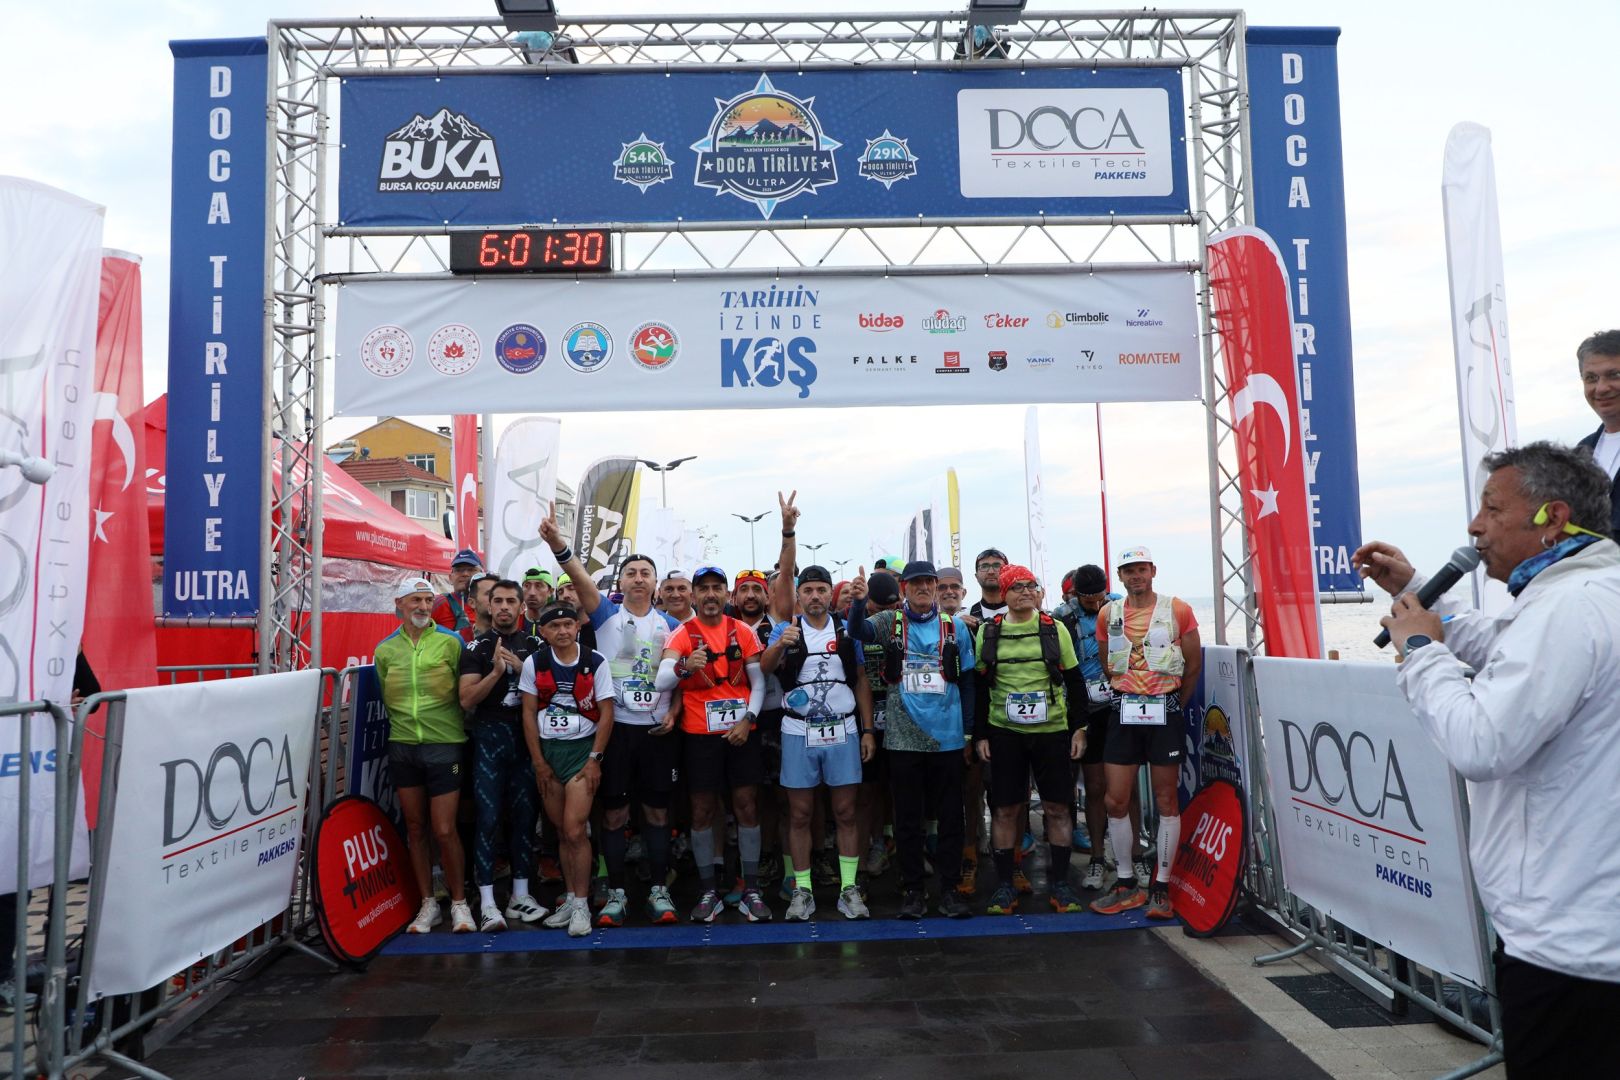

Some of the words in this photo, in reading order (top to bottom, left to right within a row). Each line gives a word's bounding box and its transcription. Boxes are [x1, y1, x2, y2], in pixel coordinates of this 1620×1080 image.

[984, 105, 1145, 151] DOCA
[1281, 53, 1311, 208] DOCA
[206, 66, 232, 225] DOCA
[873, 147, 903, 160] 29K
[381, 140, 500, 179] BUKA
[629, 151, 659, 163] 54K
[716, 157, 756, 173] DOCA
[762, 154, 817, 172] TİRİLYE
[991, 158, 1081, 168] Textile
[1090, 158, 1147, 168] Tech
[747, 177, 786, 187] ULTRA
[1094, 171, 1147, 180] PAKKENS
[379, 181, 414, 192] BURSA
[415, 181, 444, 193] KOŞU
[445, 178, 501, 192] AKADEMİSİ
[720, 284, 820, 309] TARİHİN
[720, 311, 822, 331] İZİNDE
[858, 313, 904, 330] bidaa
[983, 313, 1030, 329] Teker
[1065, 312, 1110, 322] Climbolic
[1126, 319, 1163, 327] hicreative
[853, 355, 918, 365] FALKE
[1118, 353, 1180, 365] ROMATEM
[720, 336, 818, 399] KOŞ
[174, 570, 250, 601] ULTRA
[922, 673, 932, 684] 9
[633, 691, 653, 702] 80
[718, 709, 737, 722] 71
[1017, 703, 1037, 715] 27
[1138, 703, 1147, 715] 1
[549, 716, 569, 728] 53
[817, 726, 836, 738] 11
[1278, 719, 1424, 832] DOCA
[160, 733, 298, 847] DOCA
[1190, 812, 1233, 862] PLUS
[1292, 806, 1361, 848] Textile
[1368, 834, 1430, 873] Tech
[162, 838, 249, 885] Textile
[257, 815, 297, 845] Tech
[257, 837, 295, 867] PAKKENS
[343, 824, 389, 878] PLUS
[1376, 863, 1433, 899] PAKKENS
